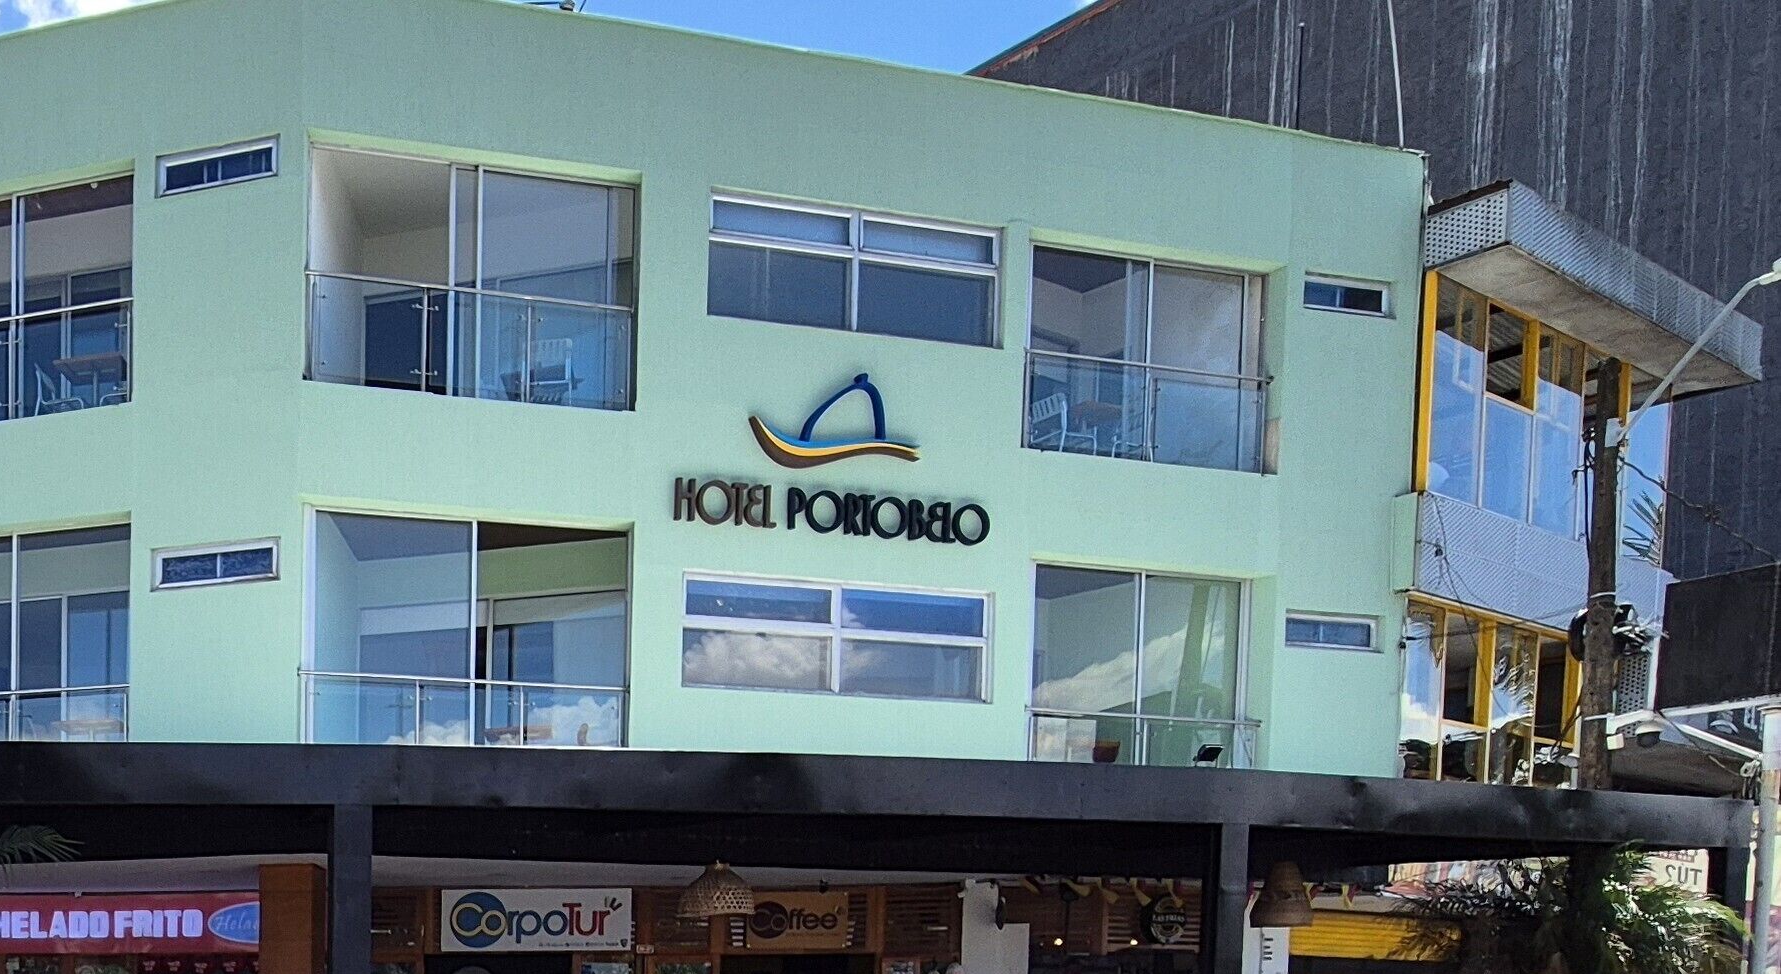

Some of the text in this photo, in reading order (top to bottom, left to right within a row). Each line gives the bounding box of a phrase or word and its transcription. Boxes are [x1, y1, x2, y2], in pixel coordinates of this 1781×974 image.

[673, 477, 990, 546] HOTEL PORTOBELO
[113, 909, 203, 938] FRITO
[452, 902, 611, 944] CorpoTur
[750, 908, 838, 931] Coffee
